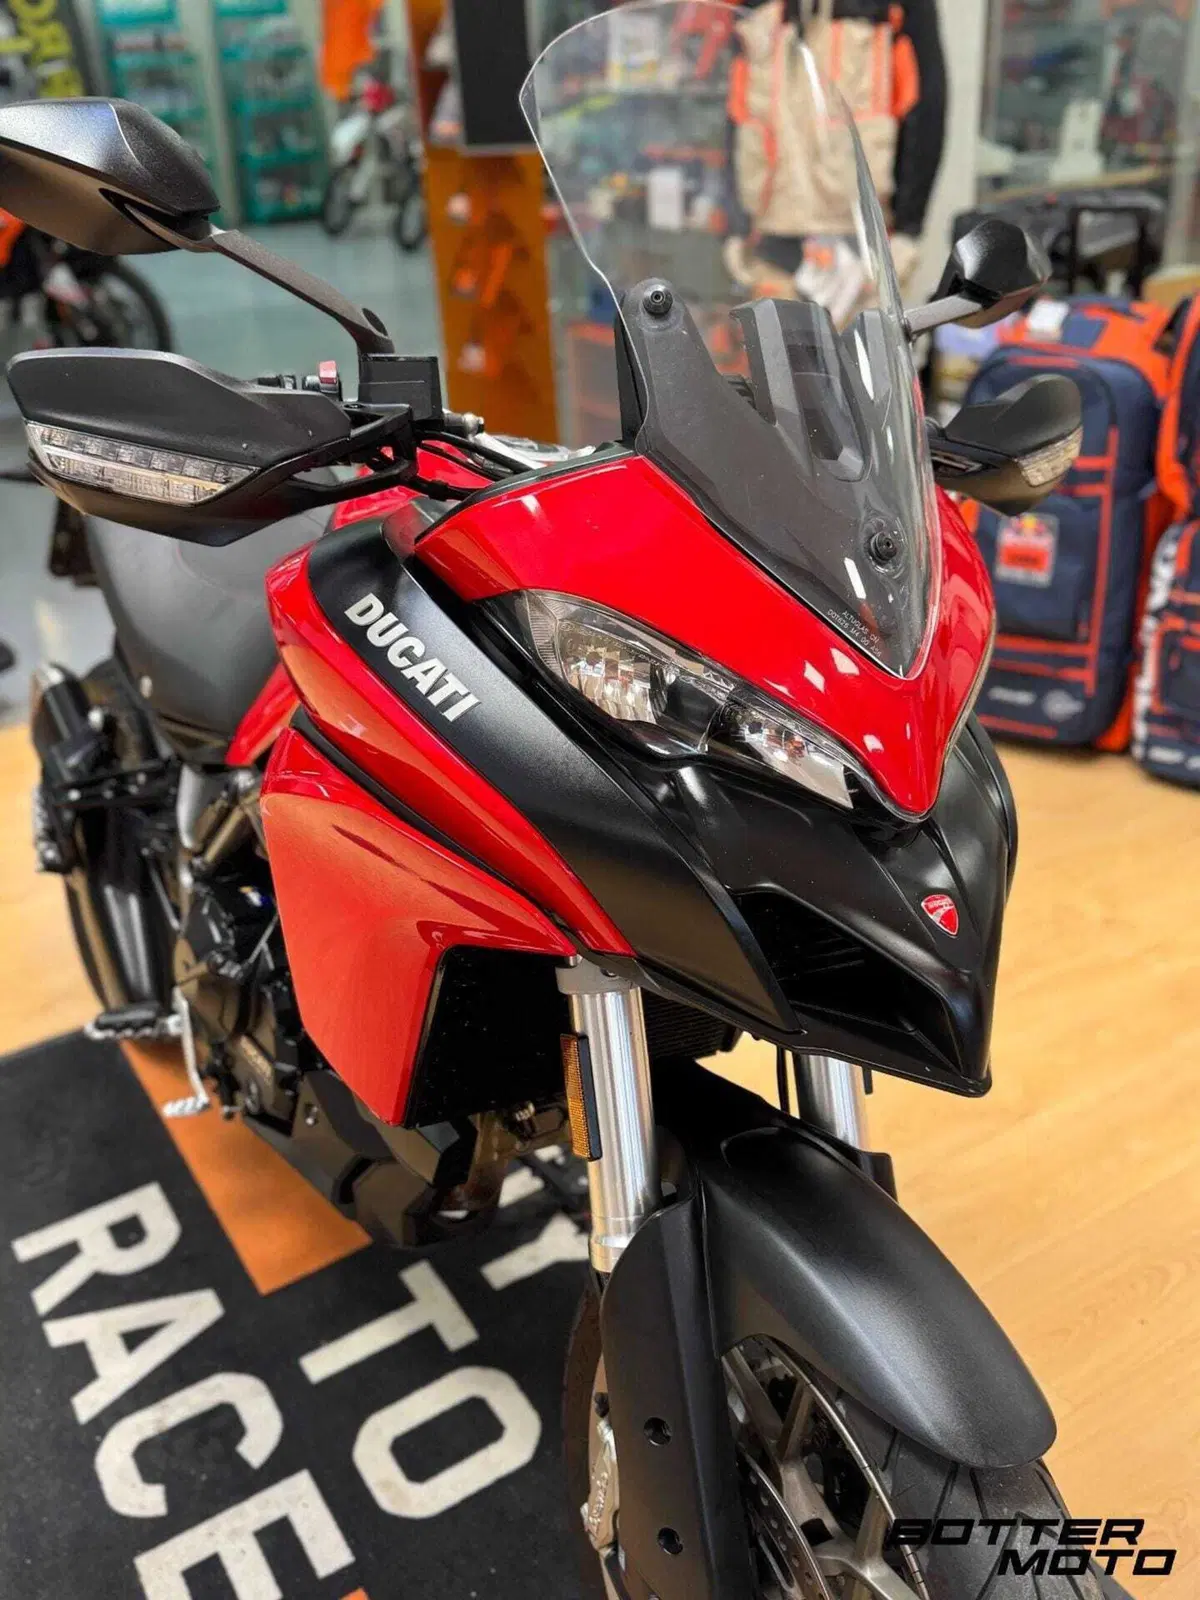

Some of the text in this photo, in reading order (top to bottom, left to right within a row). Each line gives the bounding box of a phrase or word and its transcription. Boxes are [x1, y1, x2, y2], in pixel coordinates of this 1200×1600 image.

[344, 592, 481, 722] DUCATI
[842, 611, 869, 634] ALTUGLAS
[11, 1181, 356, 1600] RACE
[300, 1260, 542, 1520] TO
